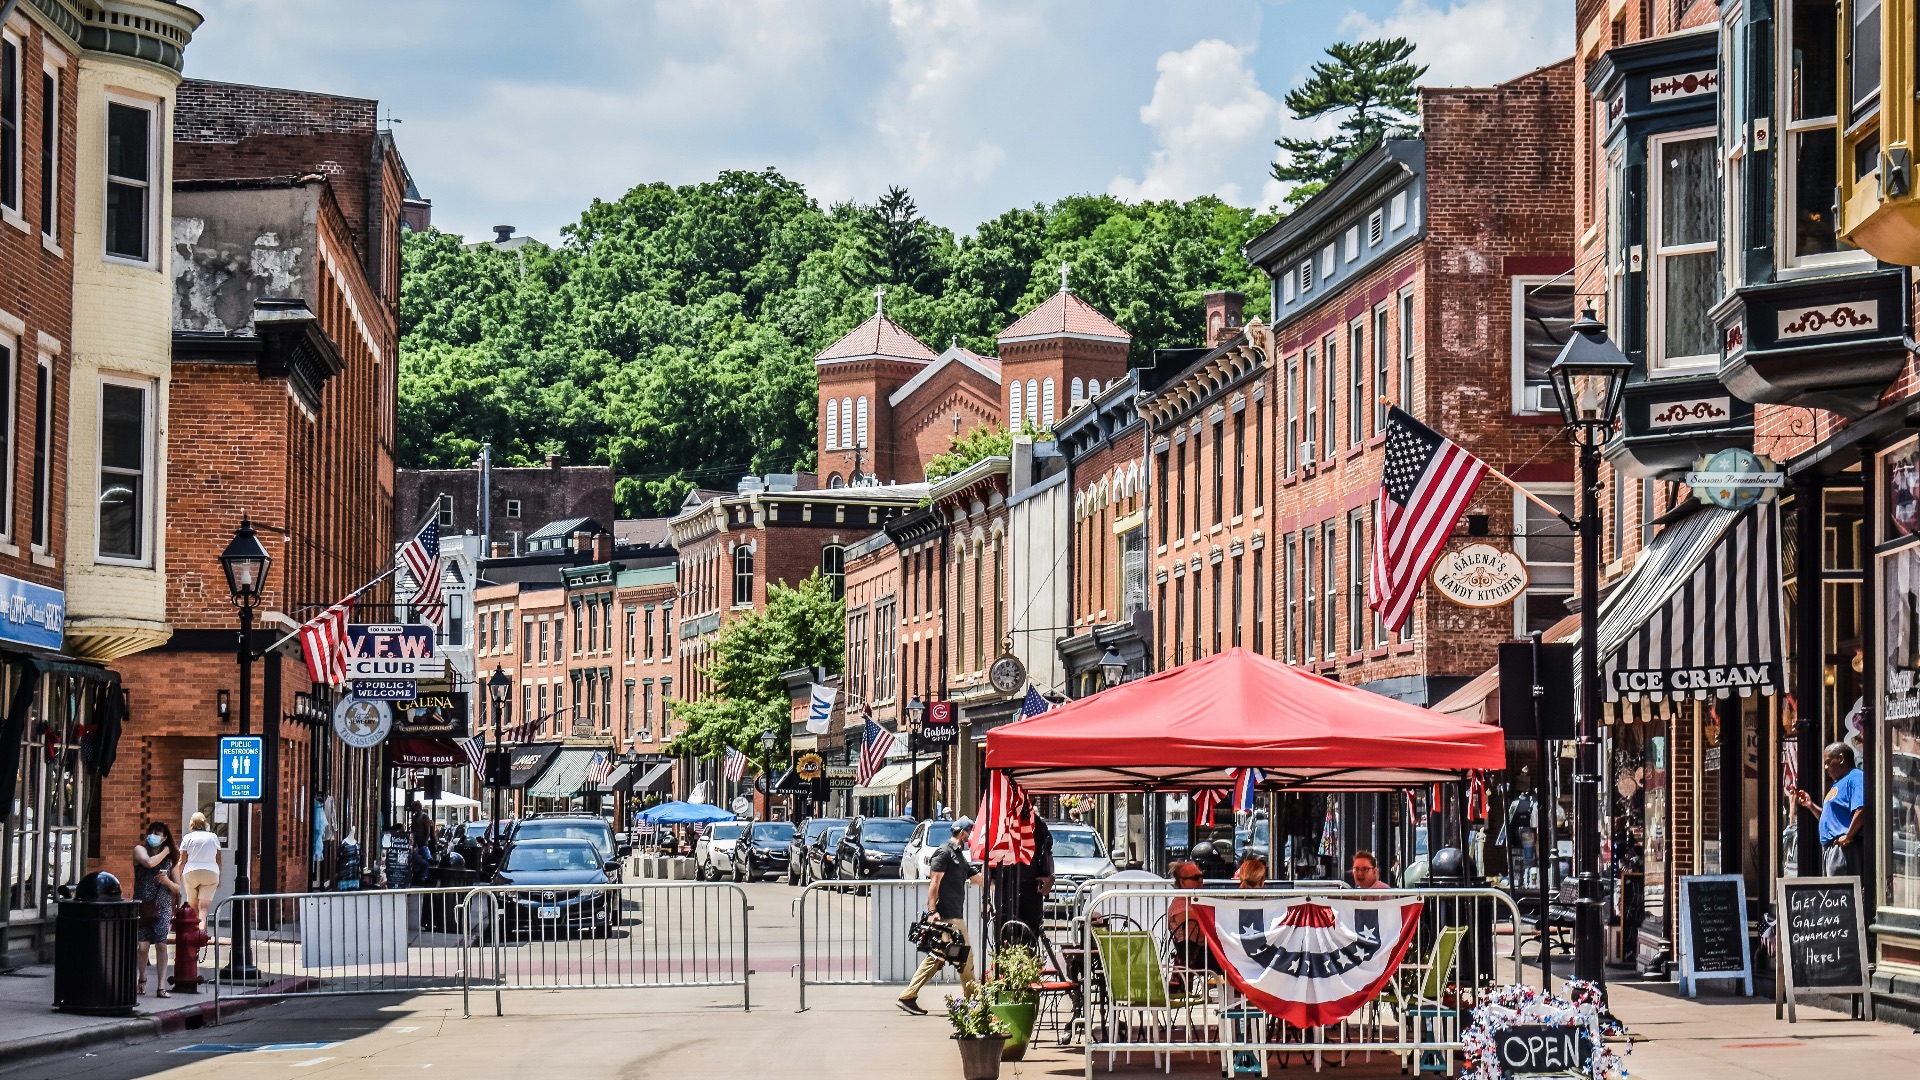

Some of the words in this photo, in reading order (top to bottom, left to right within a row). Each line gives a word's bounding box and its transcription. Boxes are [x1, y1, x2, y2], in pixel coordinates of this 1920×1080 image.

[1691, 474, 1722, 484] Seasons
[1724, 474, 1781, 484] Remembered
[1454, 554, 1506, 572] GALENA'S
[1439, 574, 1473, 600] KANDY
[1477, 573, 1522, 601] KITCHEN
[356, 661, 415, 674] CLUB
[365, 681, 404, 689] PUBLIC
[1618, 671, 1664, 691] ICE
[1671, 665, 1770, 690] CREAM
[358, 689, 412, 697] WELCOME
[397, 696, 454, 711] GALENA
[340, 727, 385, 746] TREASURES
[923, 725, 957, 741] Gabby's
[403, 755, 430, 763] VINTAGE
[432, 755, 454, 763] SODAS
[1791, 891, 1817, 911] GET
[1817, 889, 1848, 909] YOUR
[1792, 914, 1840, 929] GALENA
[1792, 928, 1849, 943] ORNAMENTS
[1503, 1027, 1580, 1068] OPEN
